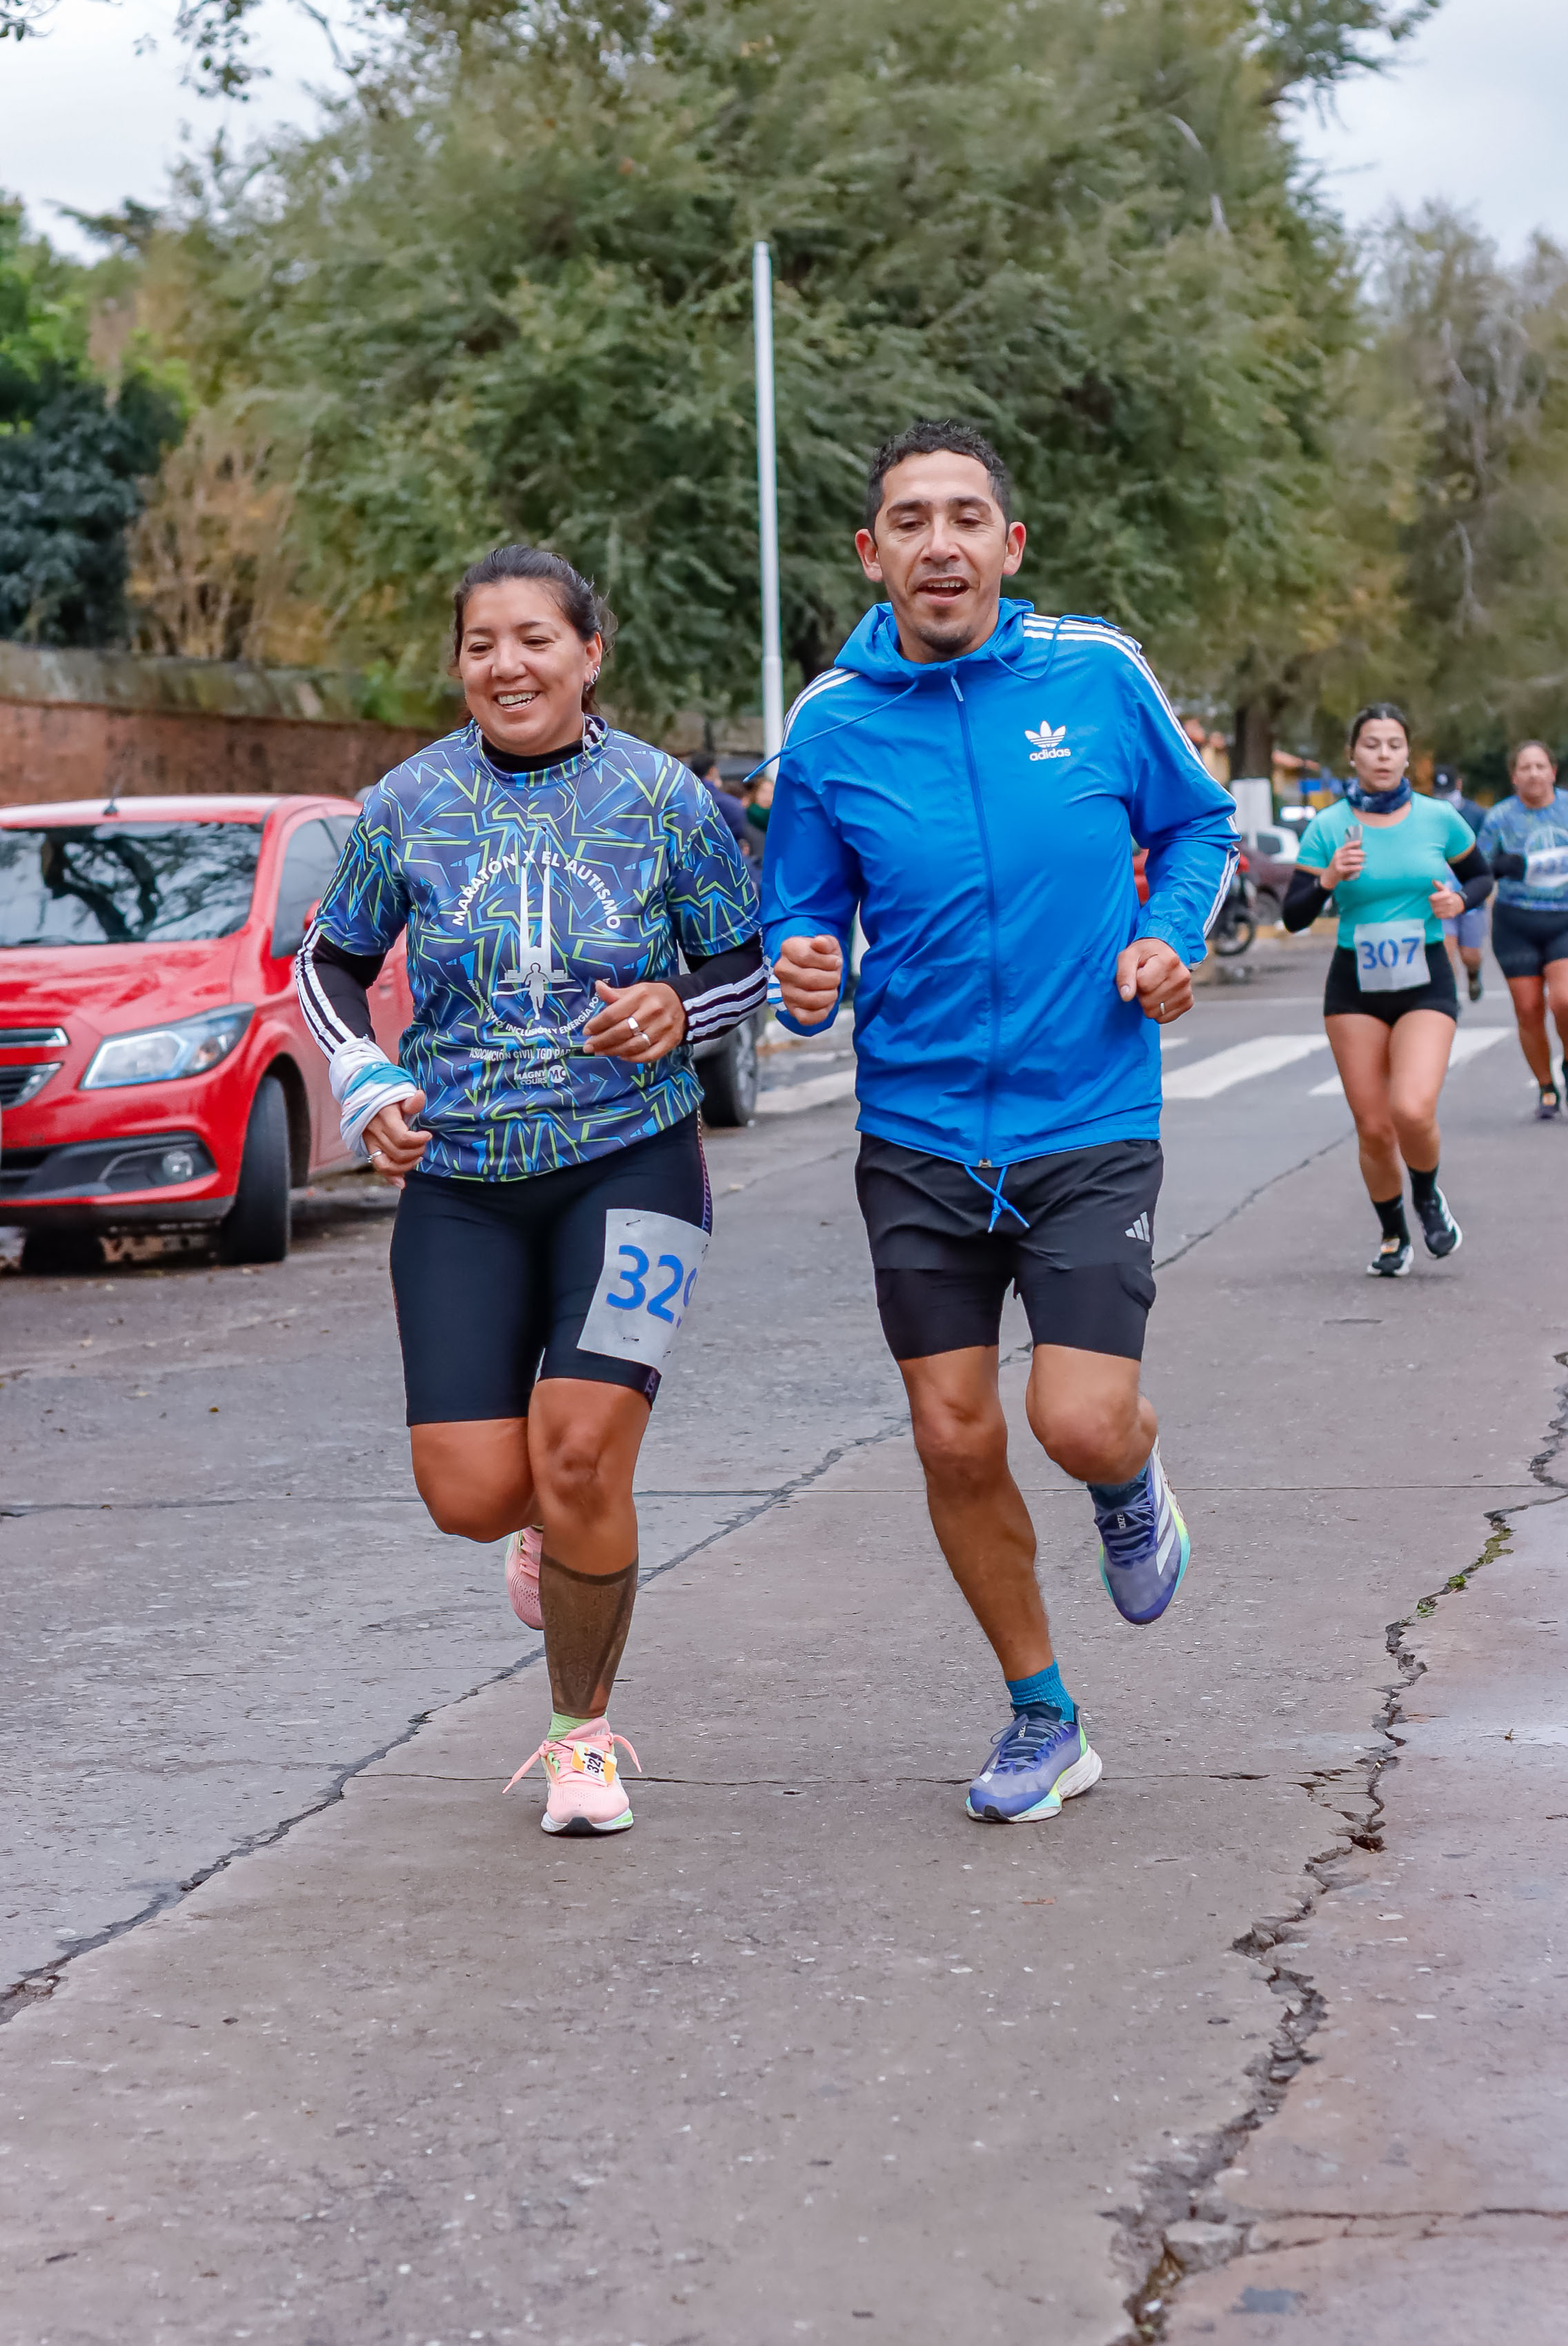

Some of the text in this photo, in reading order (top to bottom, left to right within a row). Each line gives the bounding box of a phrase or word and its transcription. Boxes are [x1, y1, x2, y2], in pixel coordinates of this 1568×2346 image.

[1029, 748, 1071, 761] adidas
[453, 850, 621, 928] MARATÓN X EL AUTISMO
[1360, 937, 1420, 970] 307
[506, 1024, 551, 1037] INCLUSIÓN
[559, 1008, 593, 1034] ENERGÍA
[513, 1048, 535, 1059] CIVIL
[536, 1048, 553, 1060] TGD
[513, 1068, 547, 1080] MAGNY
[520, 1076, 547, 1085] COURS
